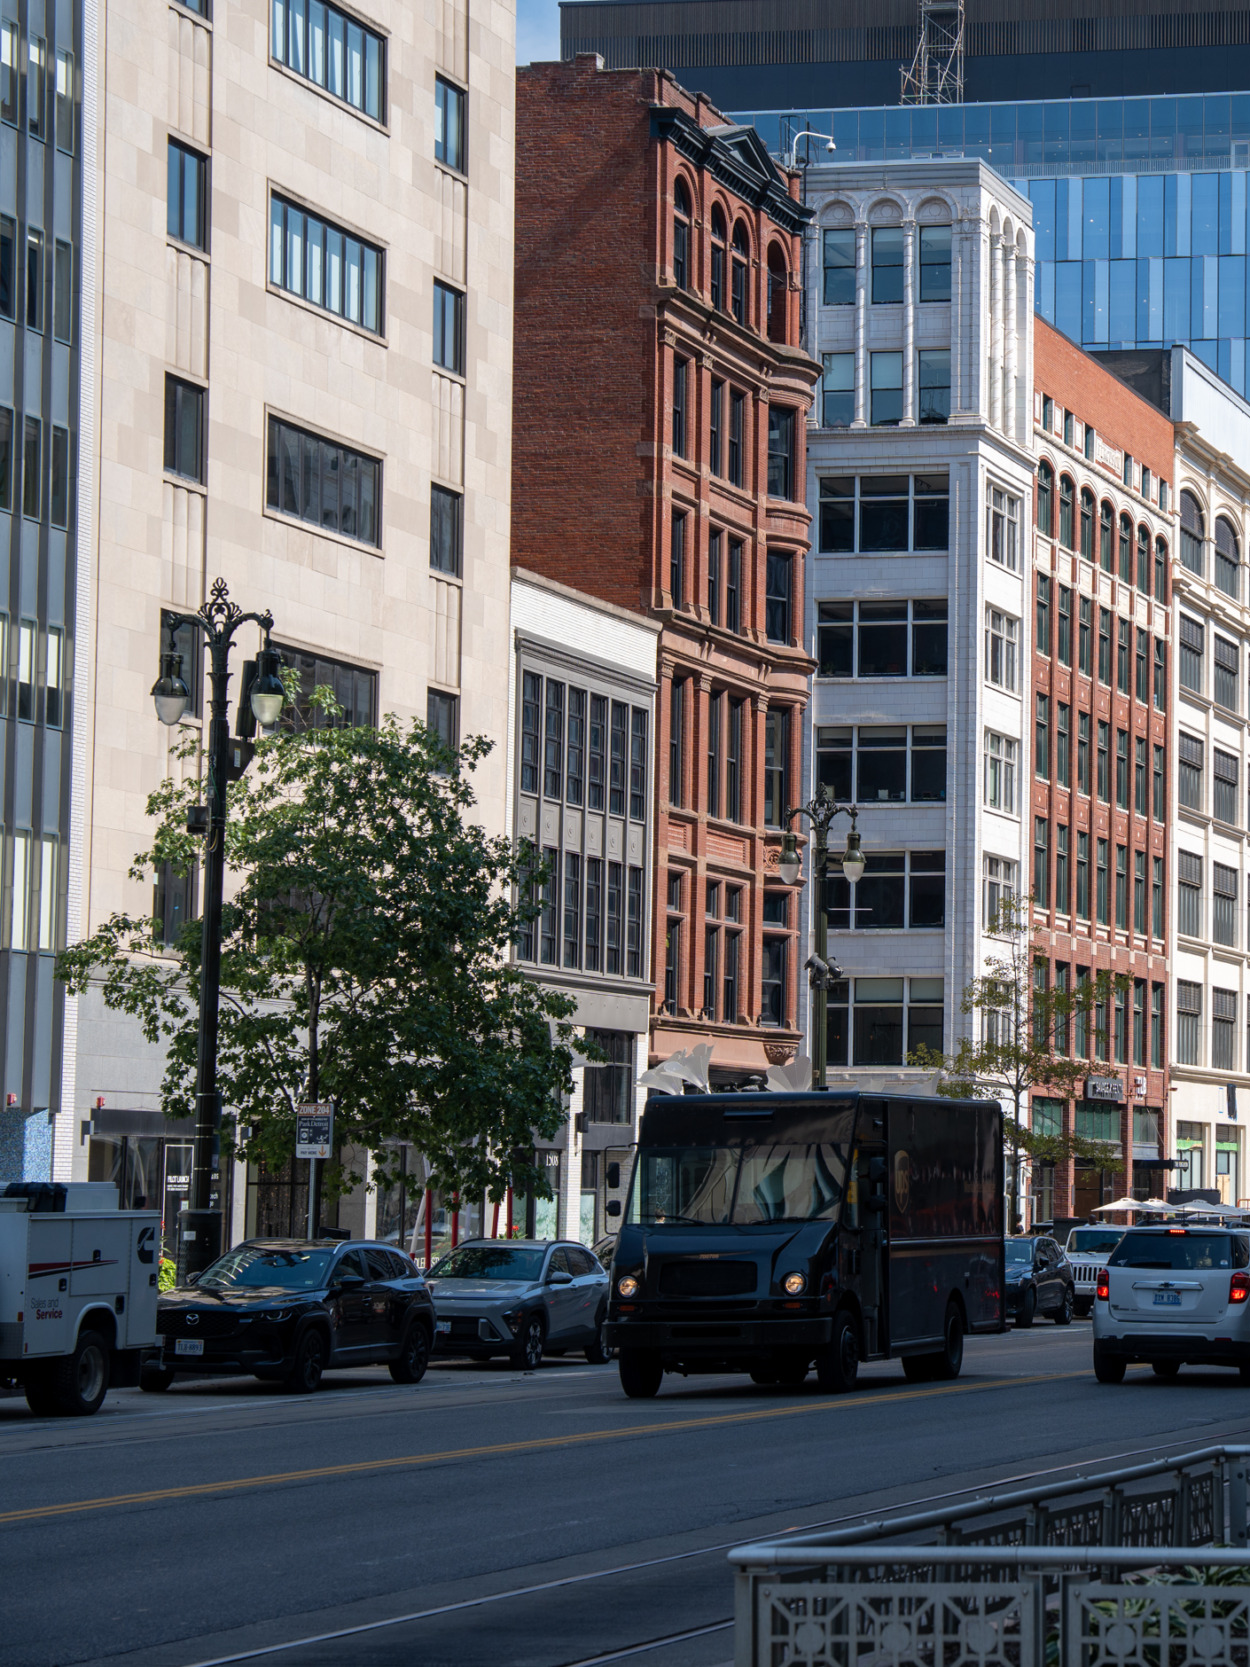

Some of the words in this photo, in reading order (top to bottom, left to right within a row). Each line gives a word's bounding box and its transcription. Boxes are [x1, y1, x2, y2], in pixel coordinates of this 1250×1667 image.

[299, 1106, 315, 1114] ZONE
[317, 1106, 330, 1114] 204
[31, 1297, 46, 1308] Sales
[47, 1298, 59, 1308] and
[36, 1309, 63, 1320] Service
